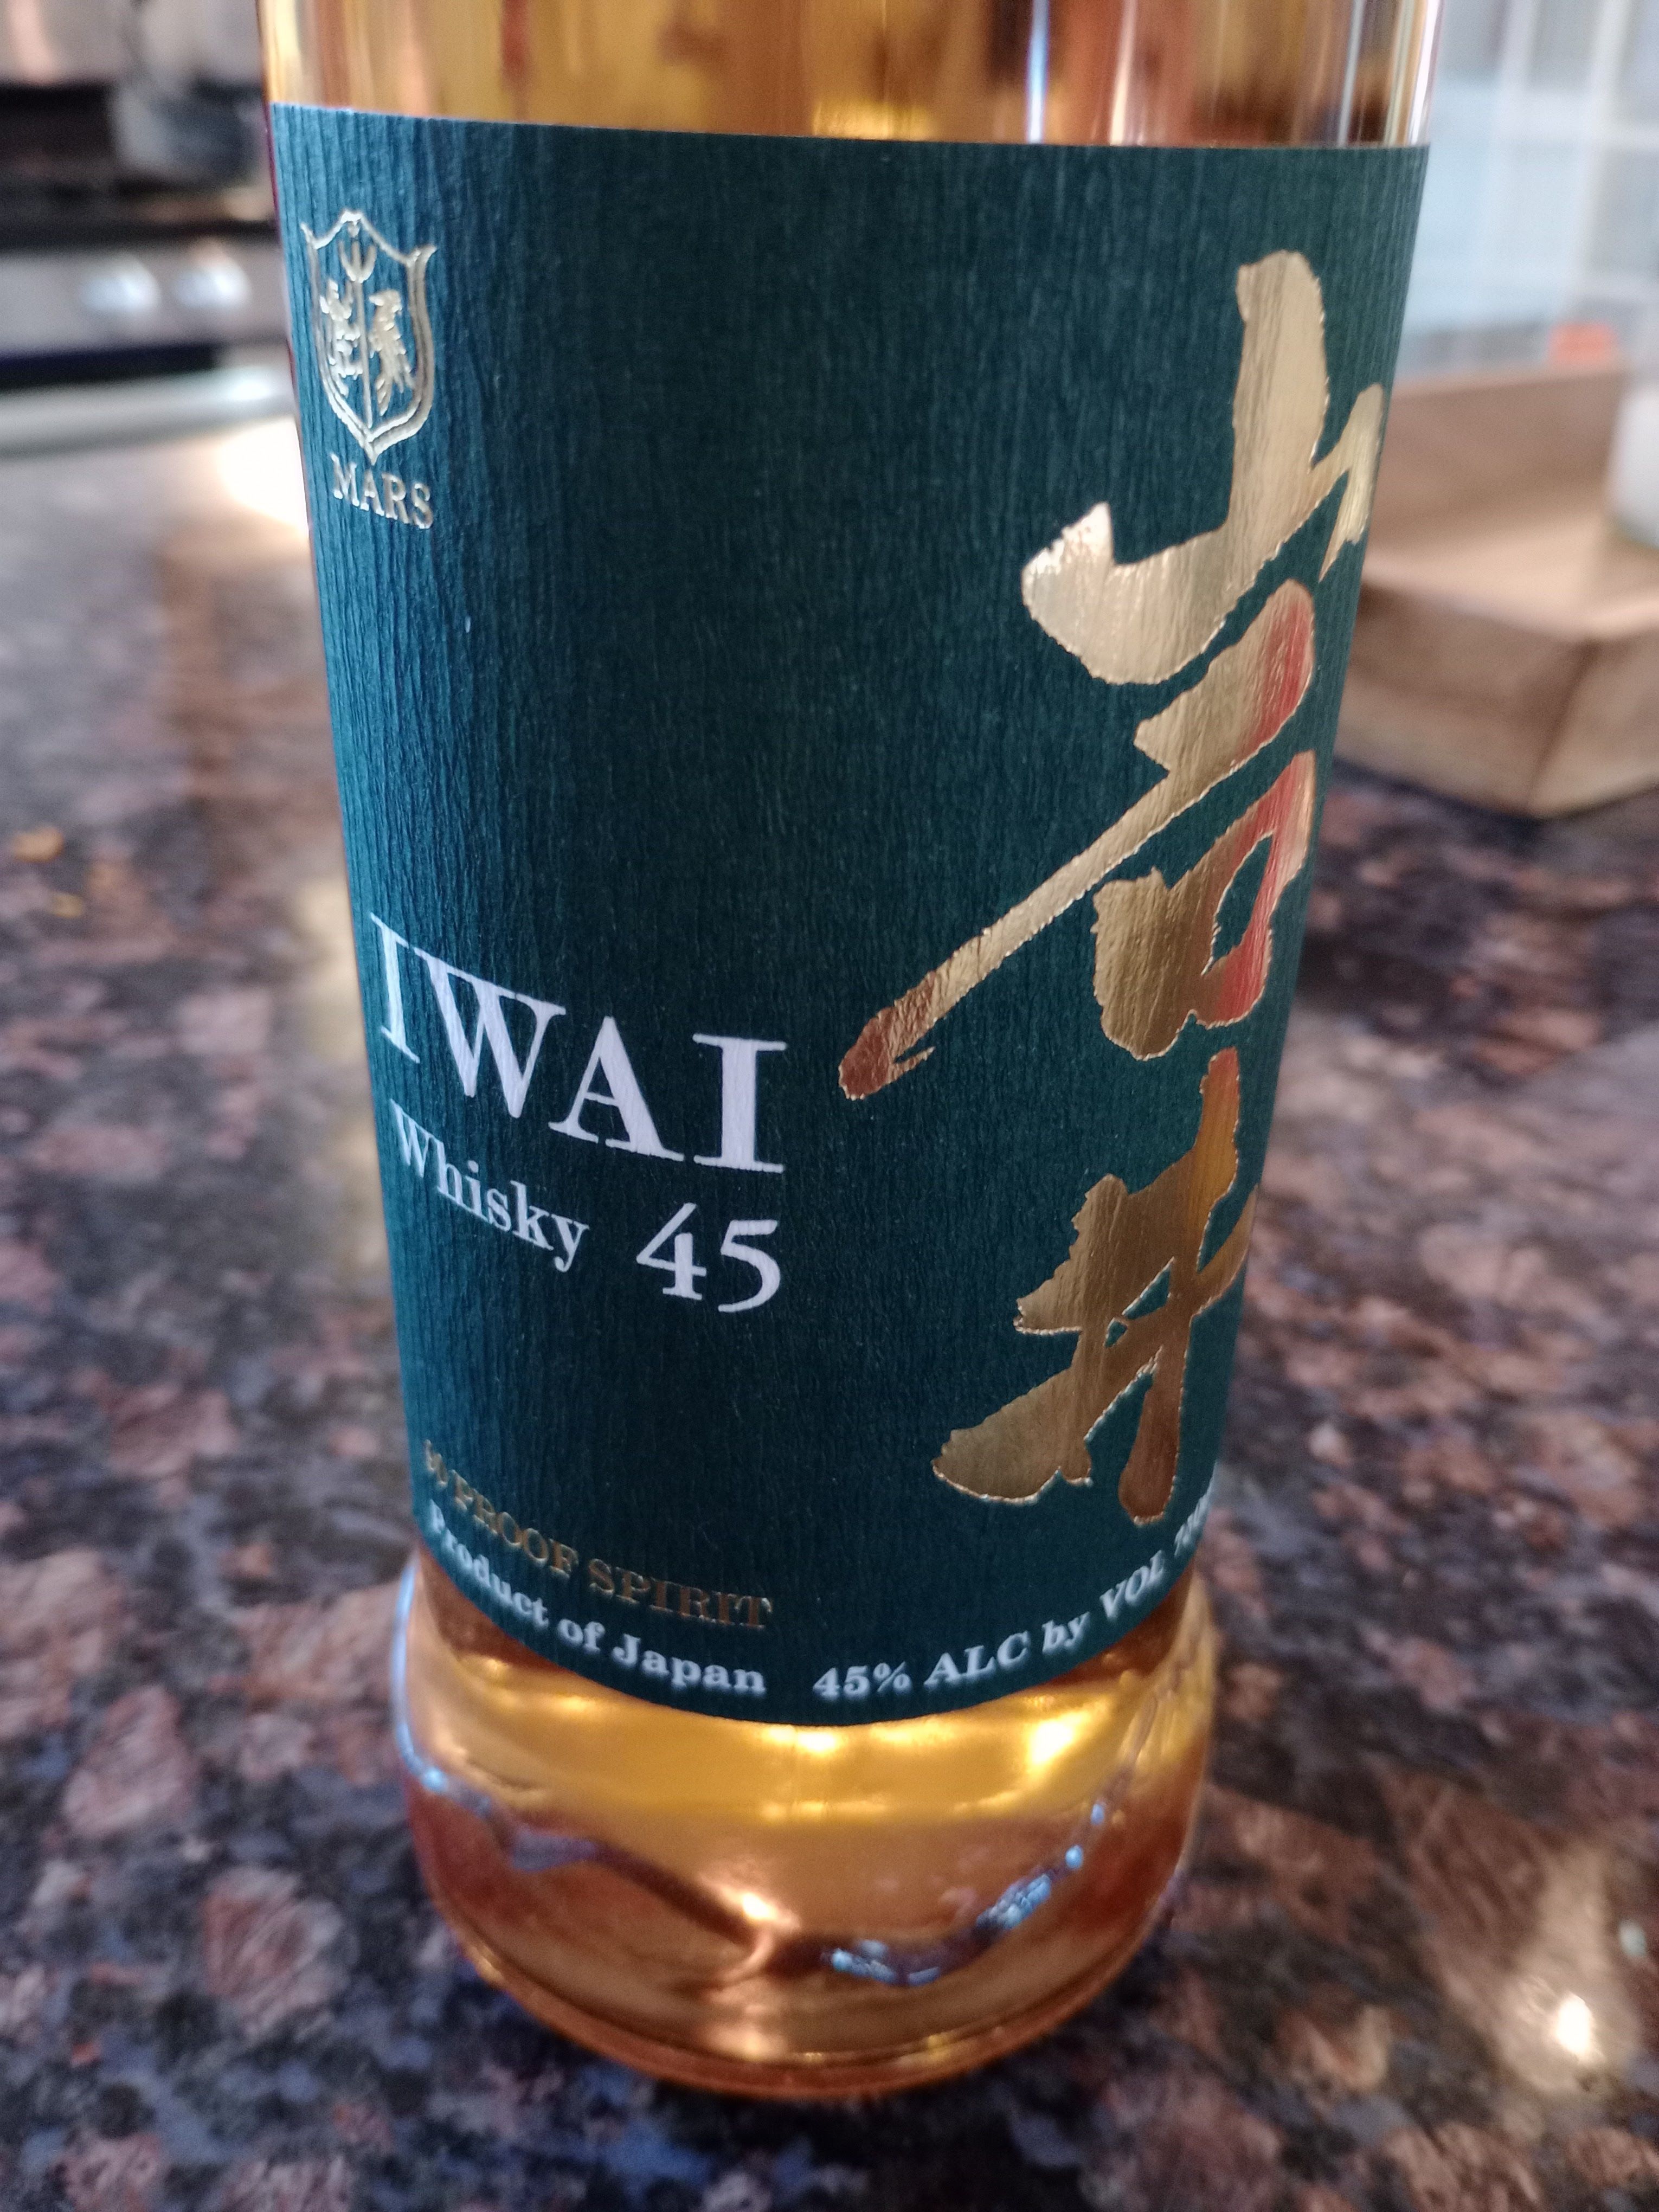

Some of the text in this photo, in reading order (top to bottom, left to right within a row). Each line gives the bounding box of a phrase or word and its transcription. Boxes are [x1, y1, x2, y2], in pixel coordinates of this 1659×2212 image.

[331, 452, 434, 529] MARS
[370, 912, 787, 1174] IWAI
[389, 1098, 781, 1314] Whisky 45
[428, 1499, 1165, 1700] Product of Japan 45% ALC by VOL
[451, 1468, 774, 1630] PROOF SPIRIT
